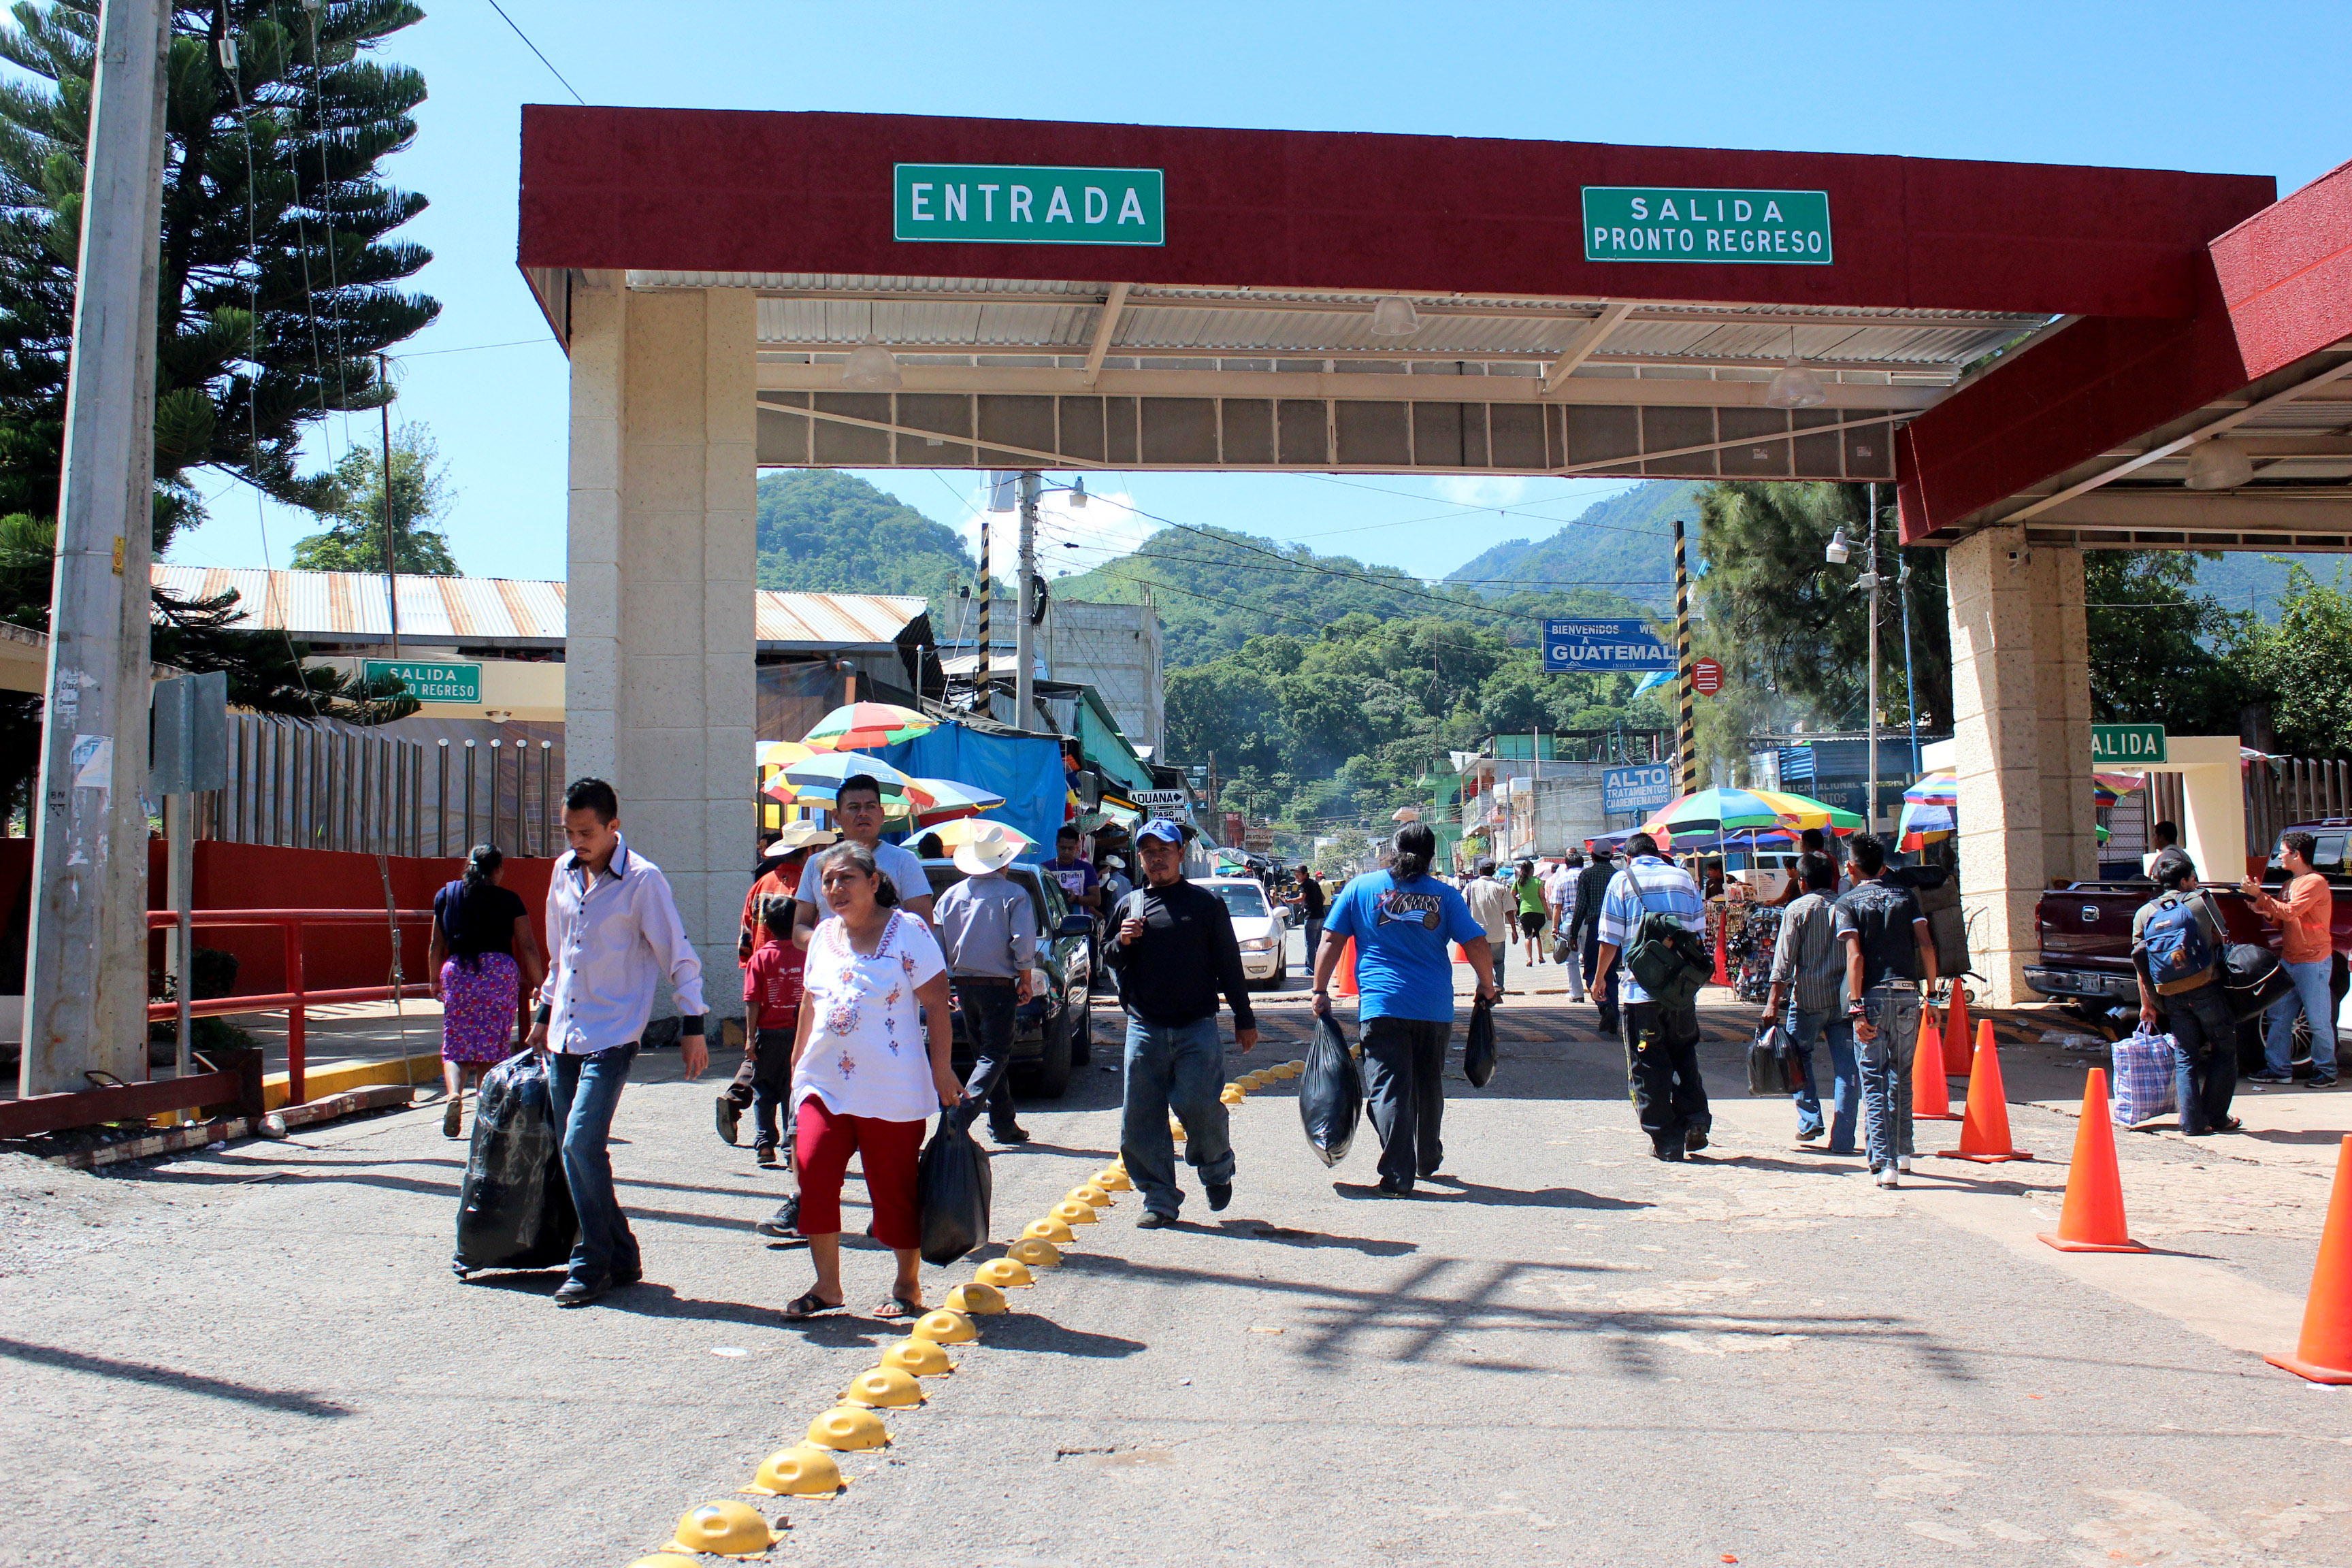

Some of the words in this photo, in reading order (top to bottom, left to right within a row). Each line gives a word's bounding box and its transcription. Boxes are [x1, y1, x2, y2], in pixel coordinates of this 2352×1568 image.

[911, 182, 1146, 225] ENTRADA
[1630, 197, 1784, 223] SALIDA
[1594, 227, 1695, 252] PRONTO
[1705, 229, 1822, 254] REGRESO
[1552, 625, 1619, 635] BIENVENIDOS
[1582, 636, 1589, 644] A
[1552, 645, 1679, 661] GUATEMAL
[389, 667, 457, 681] SALIDA
[1696, 663, 1718, 690] ALTO
[421, 683, 474, 698] REGRESO
[2091, 733, 2157, 755] ALIDA
[1607, 768, 1666, 788] ALTO
[1131, 792, 1173, 804] ADUANA
[1606, 784, 1668, 799] TRATAMIENTOS
[1606, 794, 1668, 808] CUARENTENARIOS
[1846, 889, 1875, 900] GEORGES
